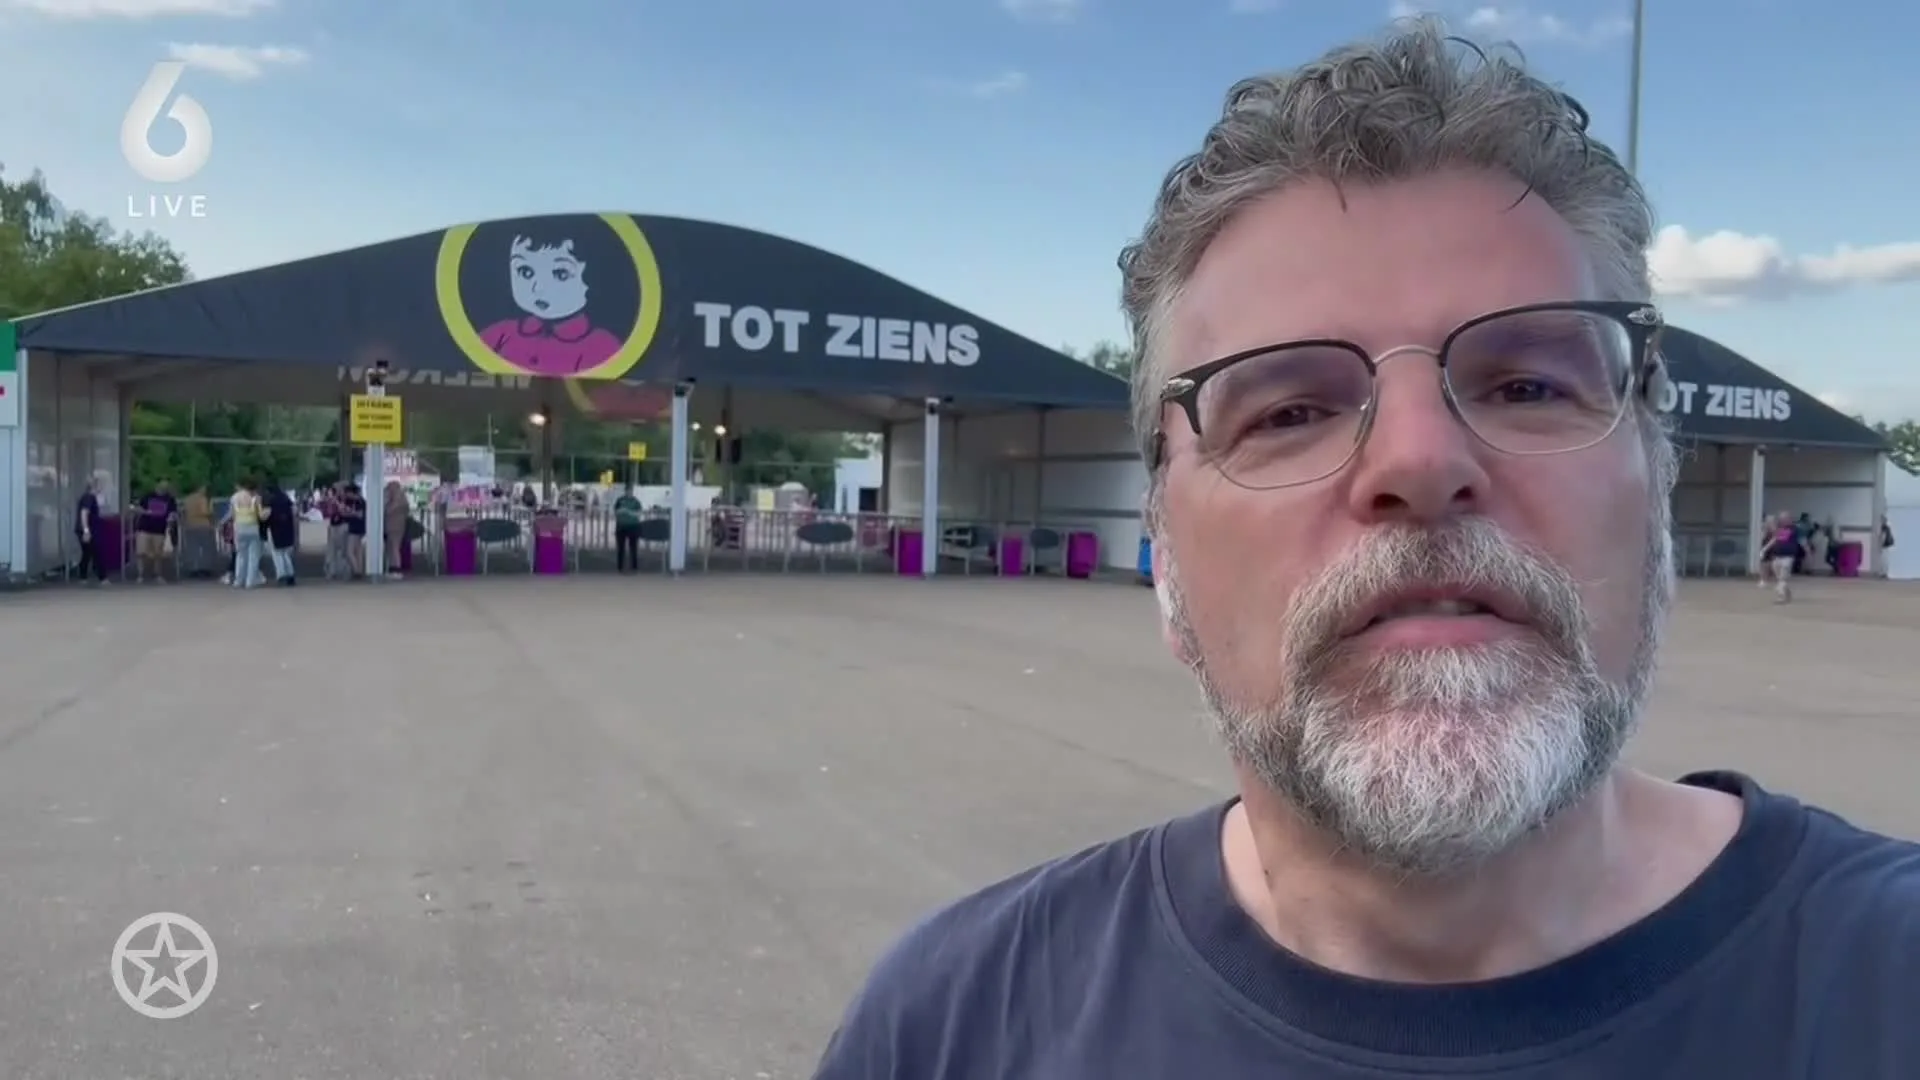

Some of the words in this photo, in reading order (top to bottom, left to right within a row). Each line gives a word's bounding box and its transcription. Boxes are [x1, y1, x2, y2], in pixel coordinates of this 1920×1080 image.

[694, 302, 809, 352] TOT
[825, 313, 981, 367] ZIENS
[1658, 381, 1698, 414] OT
[1705, 384, 1791, 421] ZIENS
